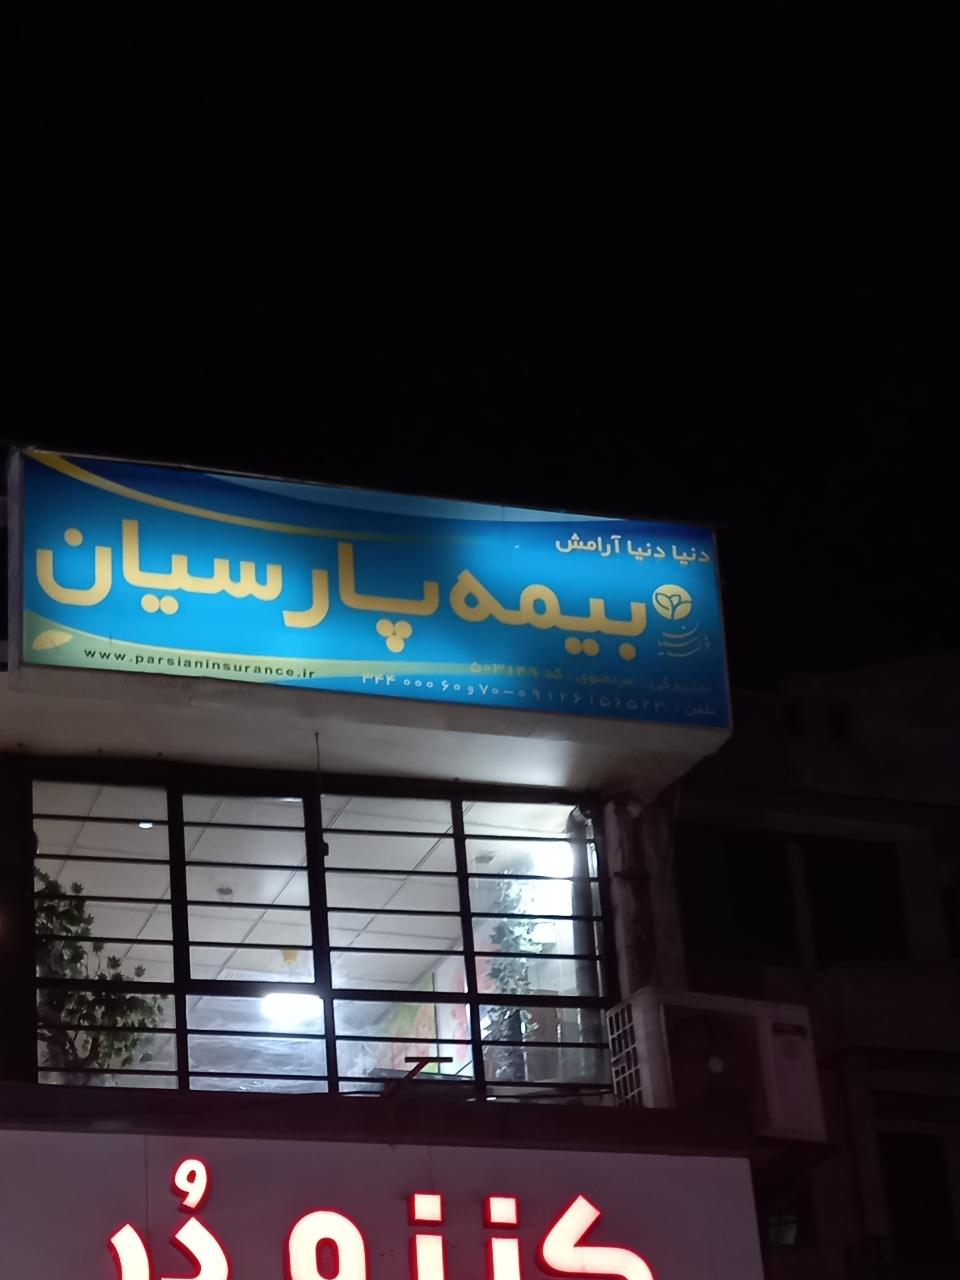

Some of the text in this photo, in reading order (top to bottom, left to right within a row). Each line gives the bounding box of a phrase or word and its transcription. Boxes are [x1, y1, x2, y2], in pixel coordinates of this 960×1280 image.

[555, 532, 710, 566] دنیا دنیا آرامش
[36, 519, 647, 660] بیمه پارسیان
[83, 646, 316, 681] www.parsianinsurance.ir
